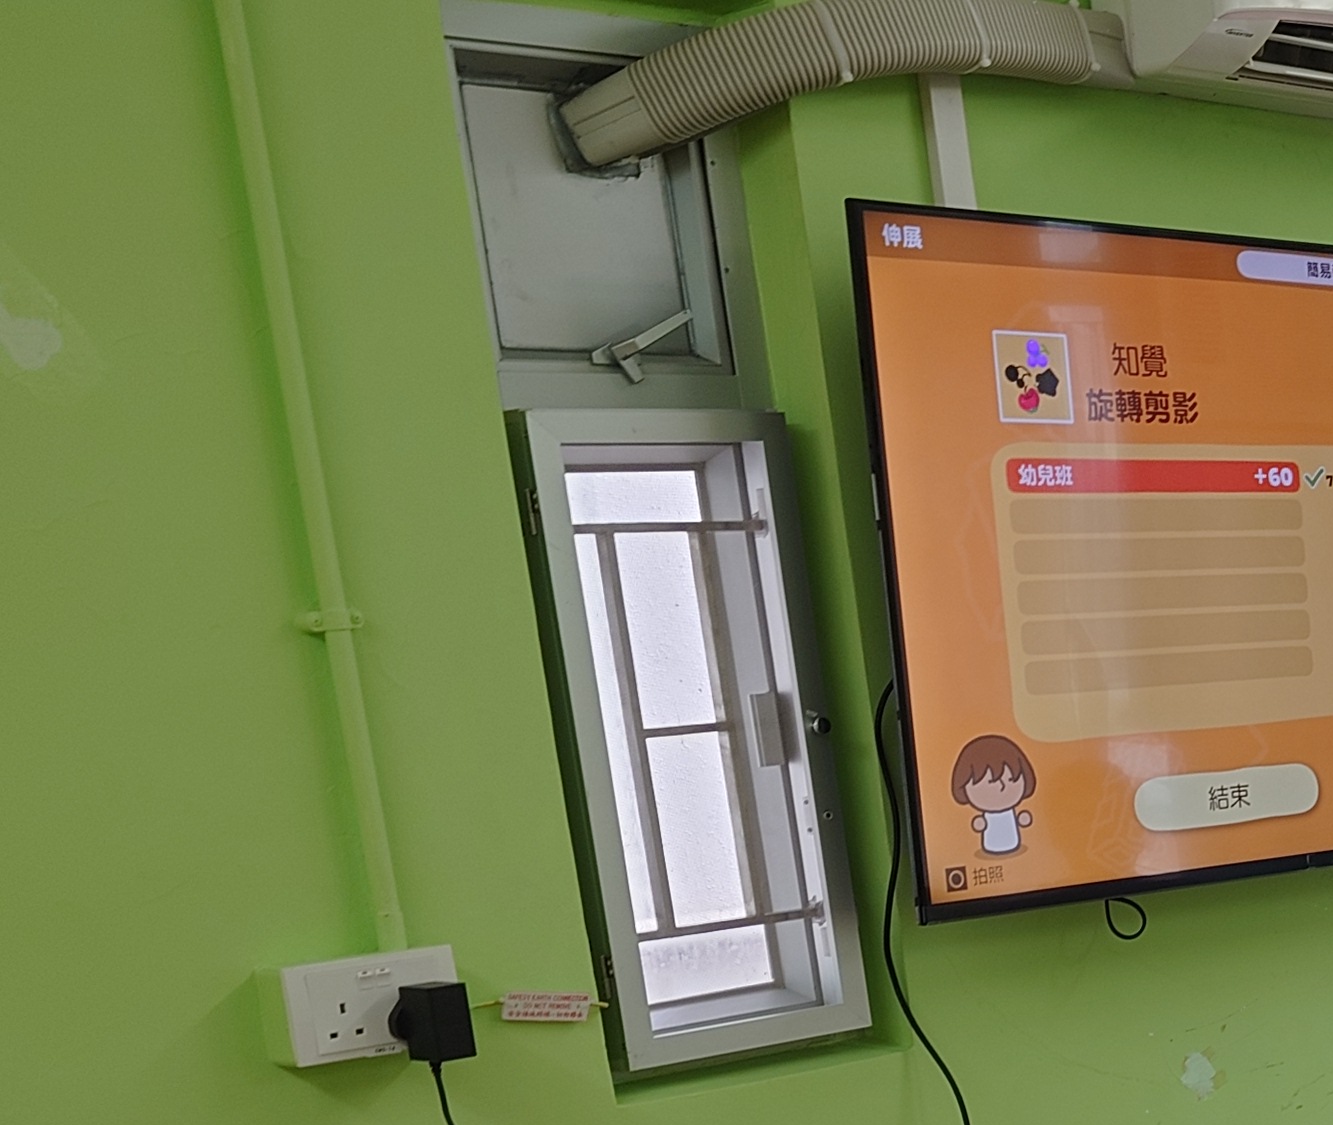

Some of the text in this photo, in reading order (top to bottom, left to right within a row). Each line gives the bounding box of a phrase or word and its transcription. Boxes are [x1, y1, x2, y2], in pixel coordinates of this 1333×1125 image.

[882, 223, 923, 249] 伸展
[1111, 343, 1168, 378] 知覺
[1086, 388, 1200, 425] 旋轉剪影
[1018, 463, 1293, 487] 幼兒班 +60
[1325, 475, 1333, 487] 7
[1208, 783, 1251, 811] 結束
[972, 865, 1004, 886] 拍照
